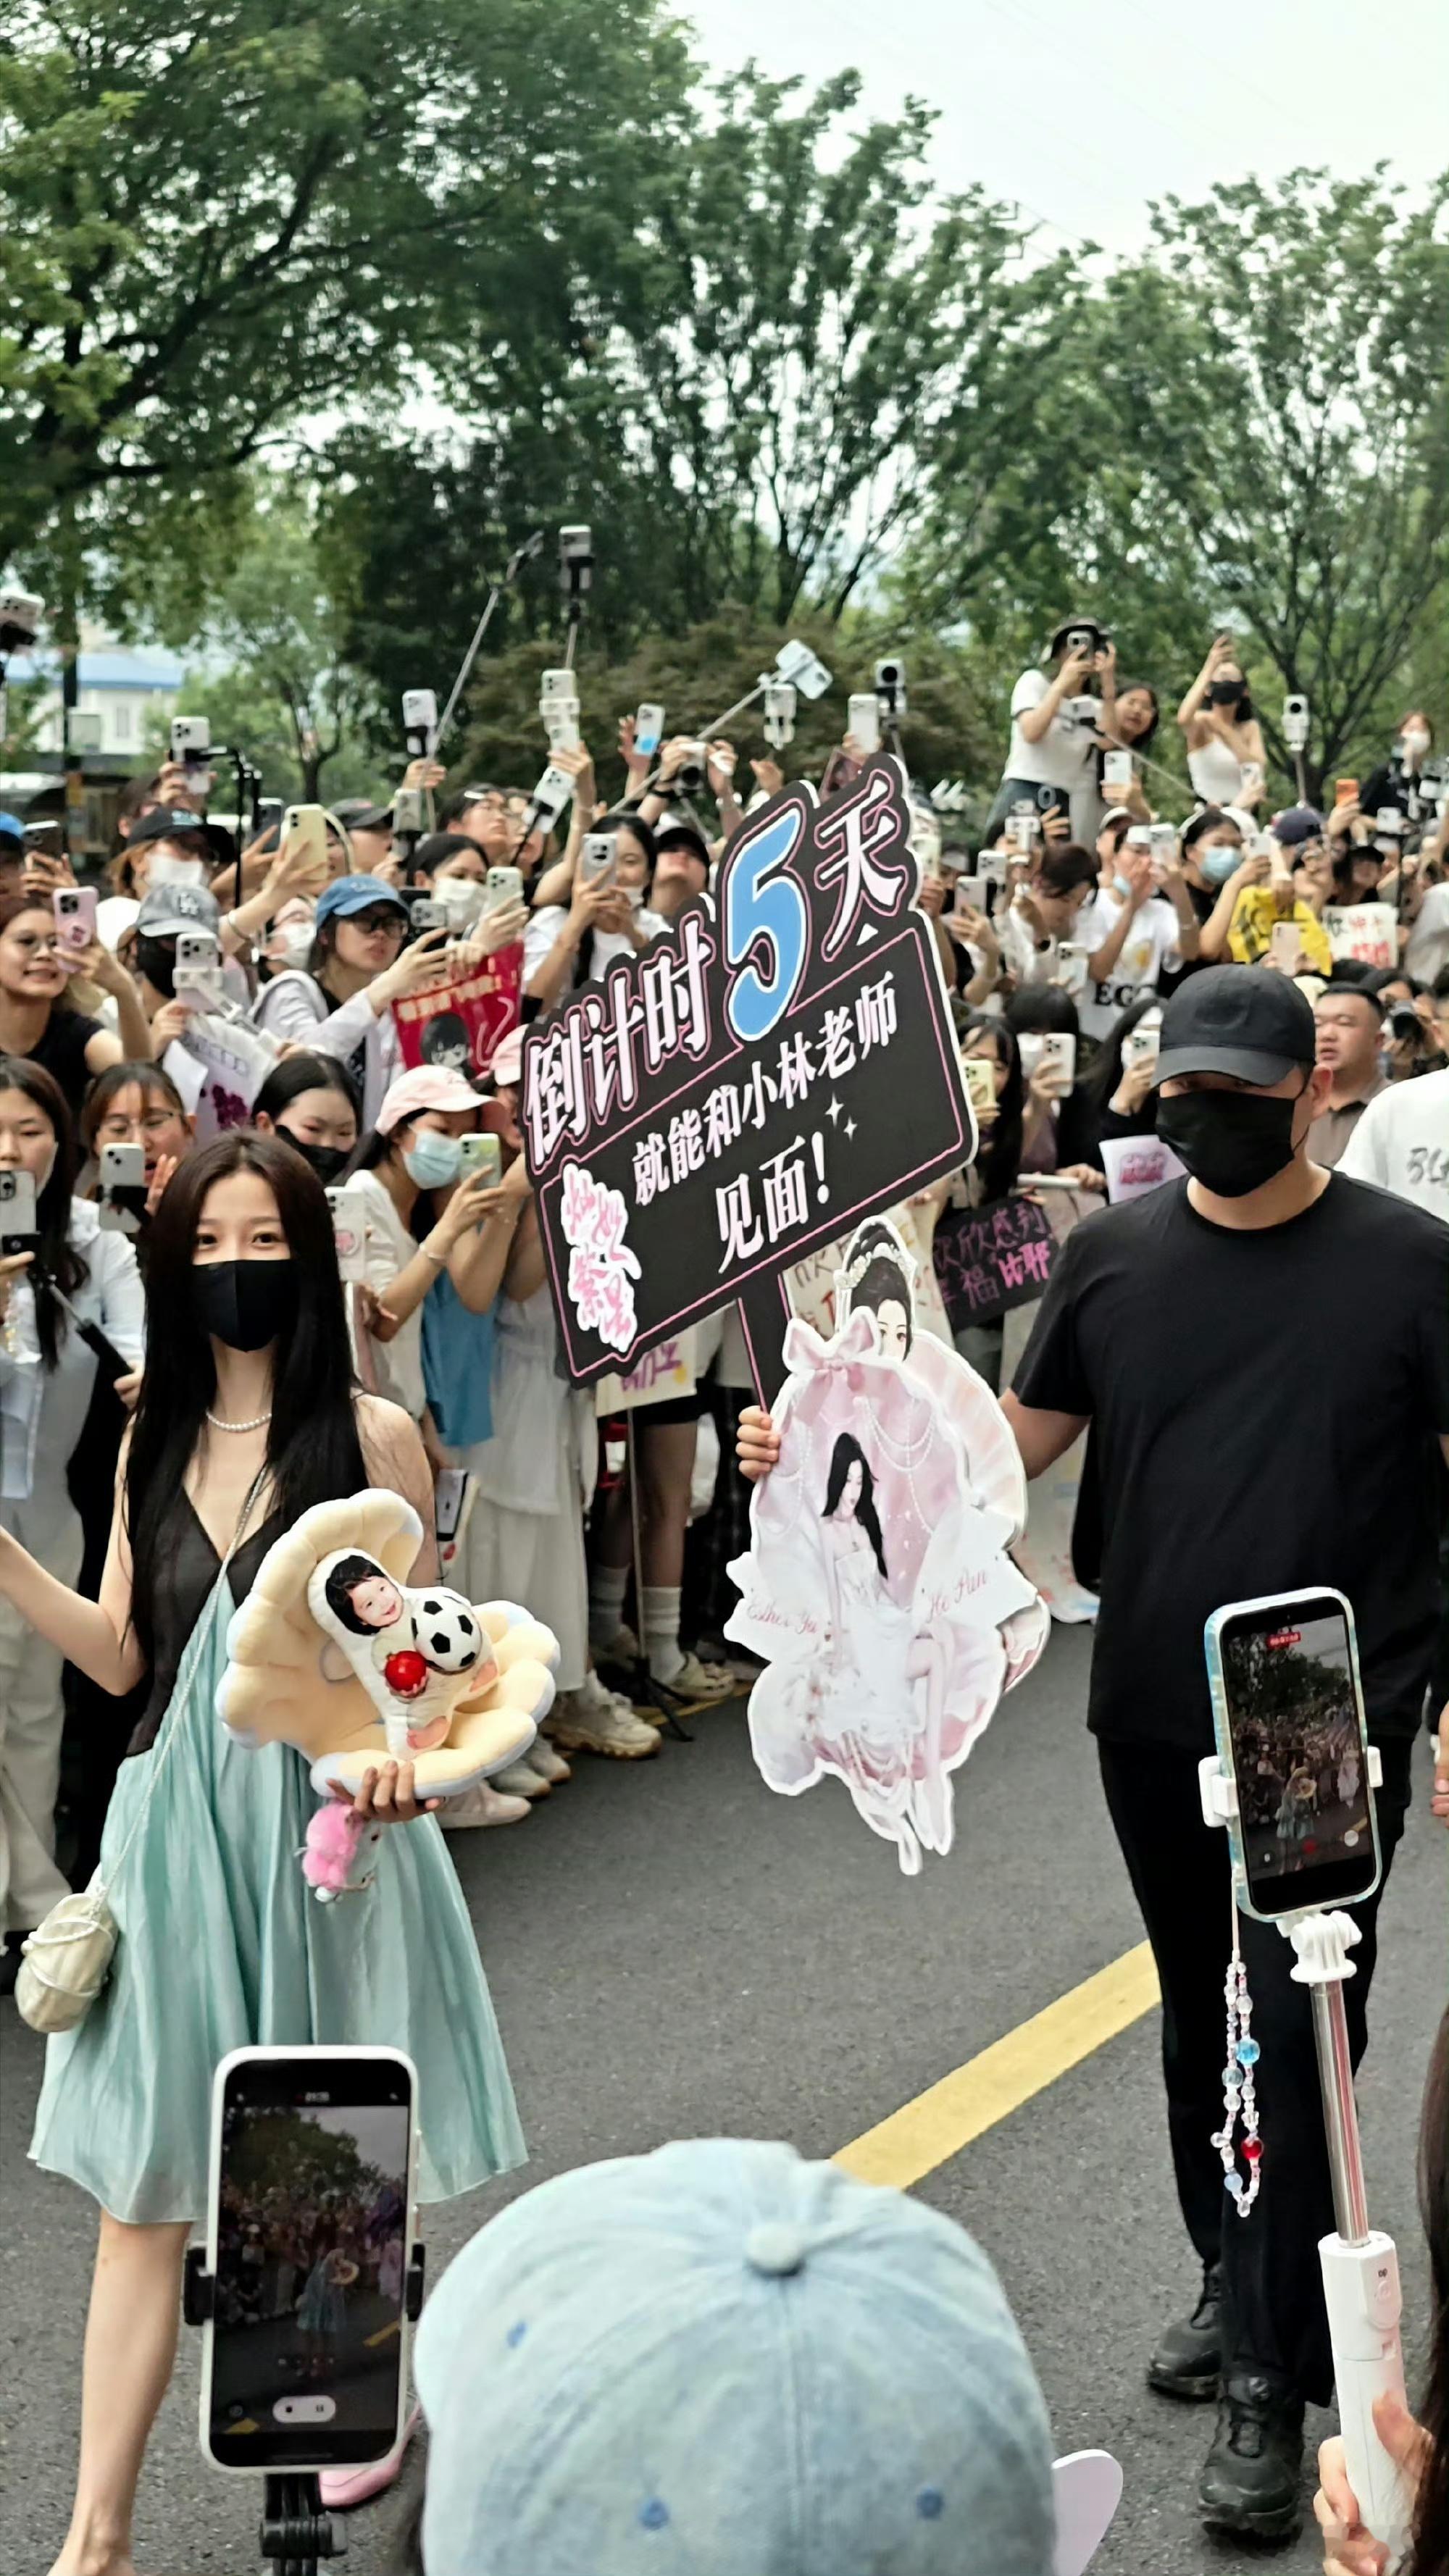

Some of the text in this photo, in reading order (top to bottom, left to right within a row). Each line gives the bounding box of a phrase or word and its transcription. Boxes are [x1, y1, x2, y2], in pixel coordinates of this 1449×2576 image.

[631, 971, 898, 1206] 就能和小林老师
